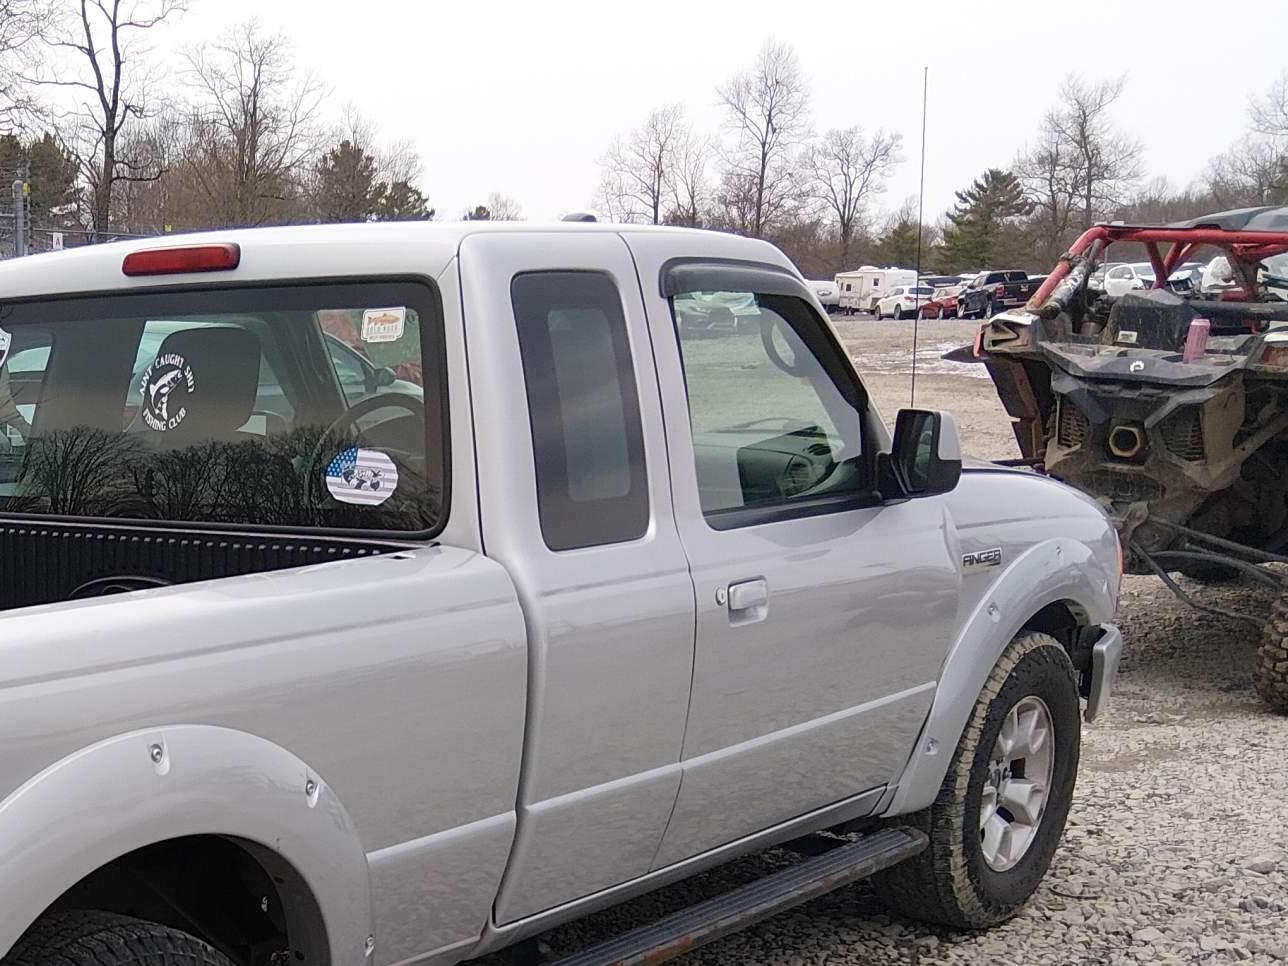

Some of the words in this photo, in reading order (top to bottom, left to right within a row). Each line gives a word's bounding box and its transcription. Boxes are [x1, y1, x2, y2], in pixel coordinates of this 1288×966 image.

[154, 353, 185, 369] CAUGHT
[142, 407, 167, 431] FISHING
[168, 407, 187, 429] CLUB
